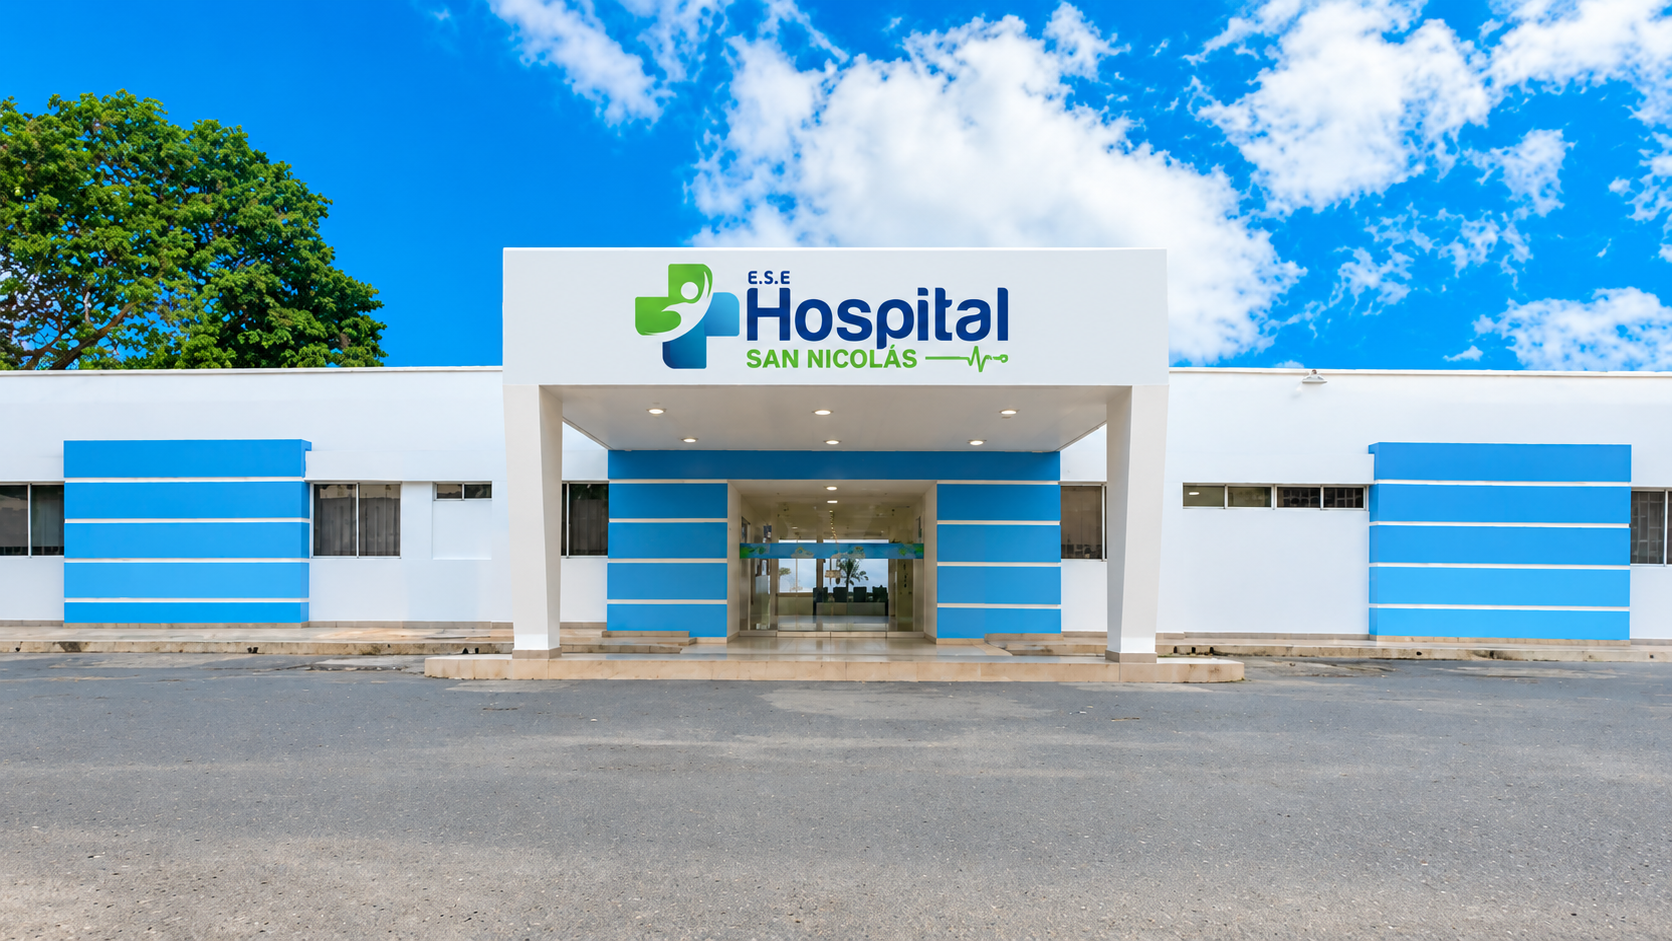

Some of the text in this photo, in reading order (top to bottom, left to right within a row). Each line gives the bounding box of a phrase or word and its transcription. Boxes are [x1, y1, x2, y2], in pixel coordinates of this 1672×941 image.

[747, 270, 791, 285] E.S.E
[746, 286, 1009, 350] Hospital
[746, 344, 918, 369] SAN NICOLÁS
